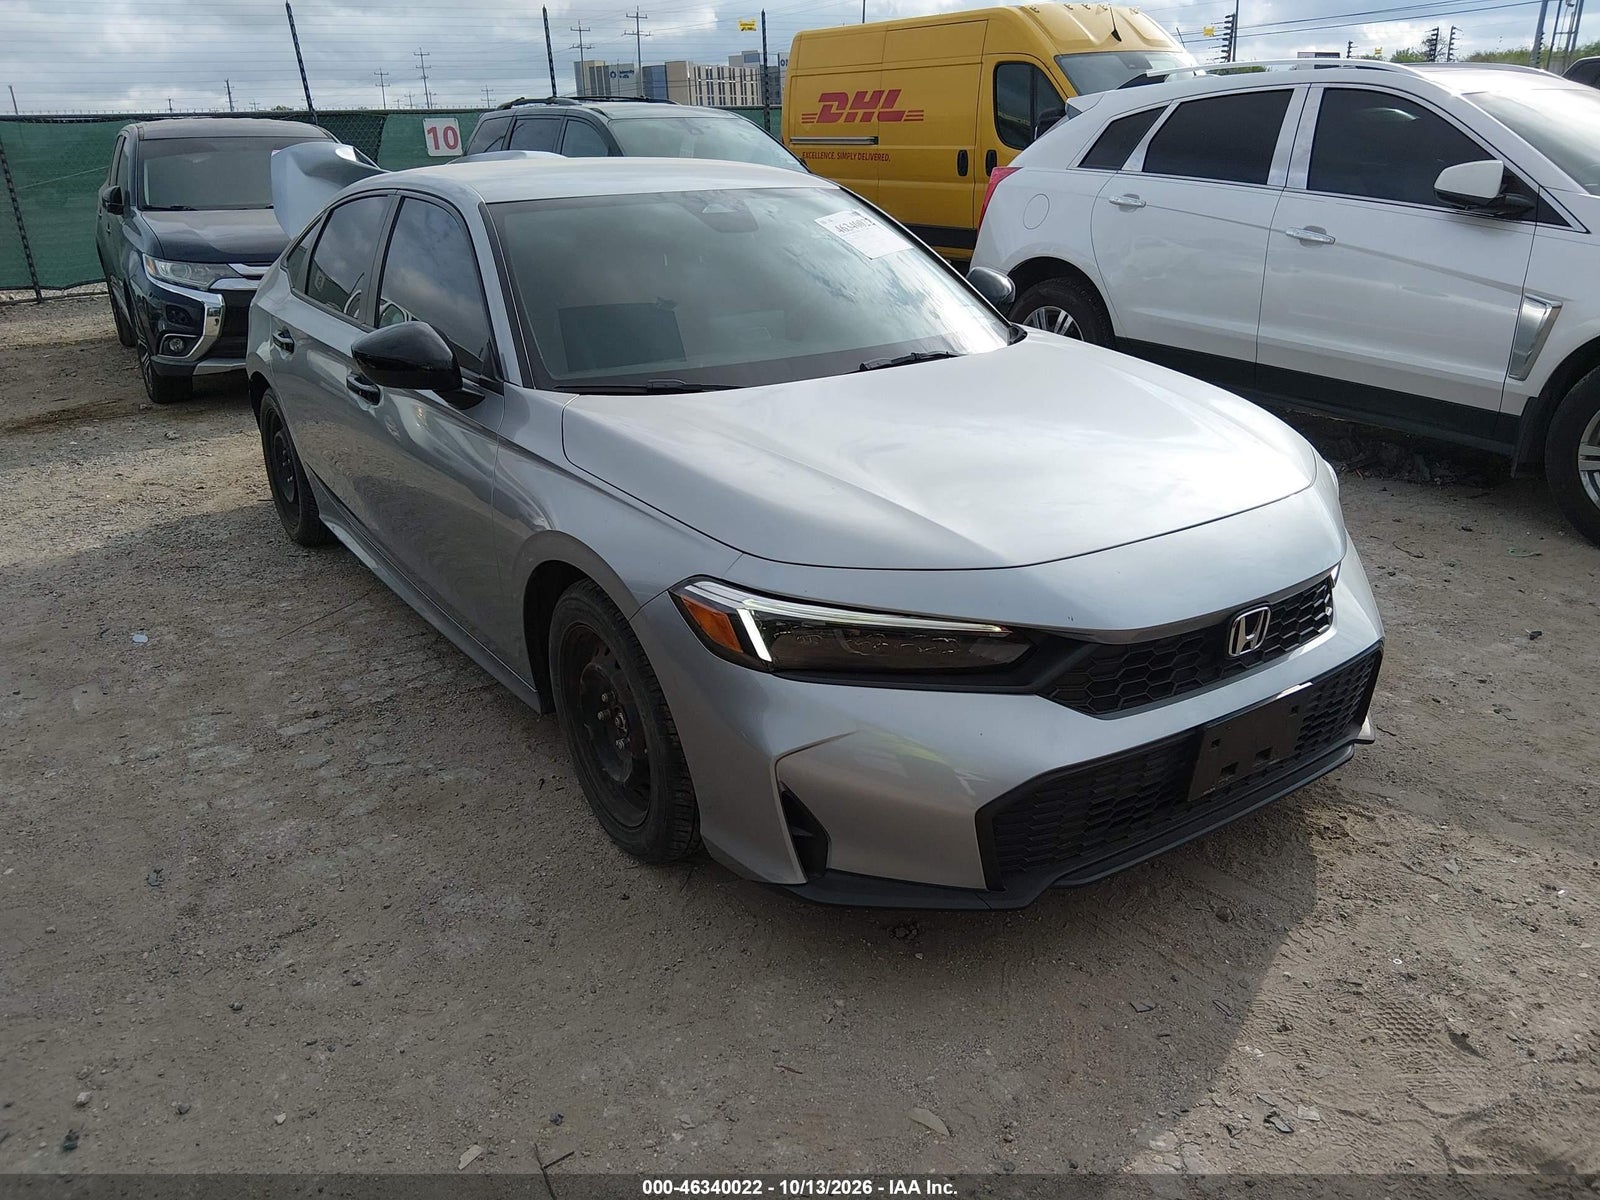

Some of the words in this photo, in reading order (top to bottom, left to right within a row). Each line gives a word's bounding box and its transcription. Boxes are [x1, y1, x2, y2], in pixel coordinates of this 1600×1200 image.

[816, 89, 906, 124] DHL
[427, 126, 459, 150] 10
[802, 151, 836, 160] EXCELLENCE.
[837, 151, 858, 161] SIMPLY
